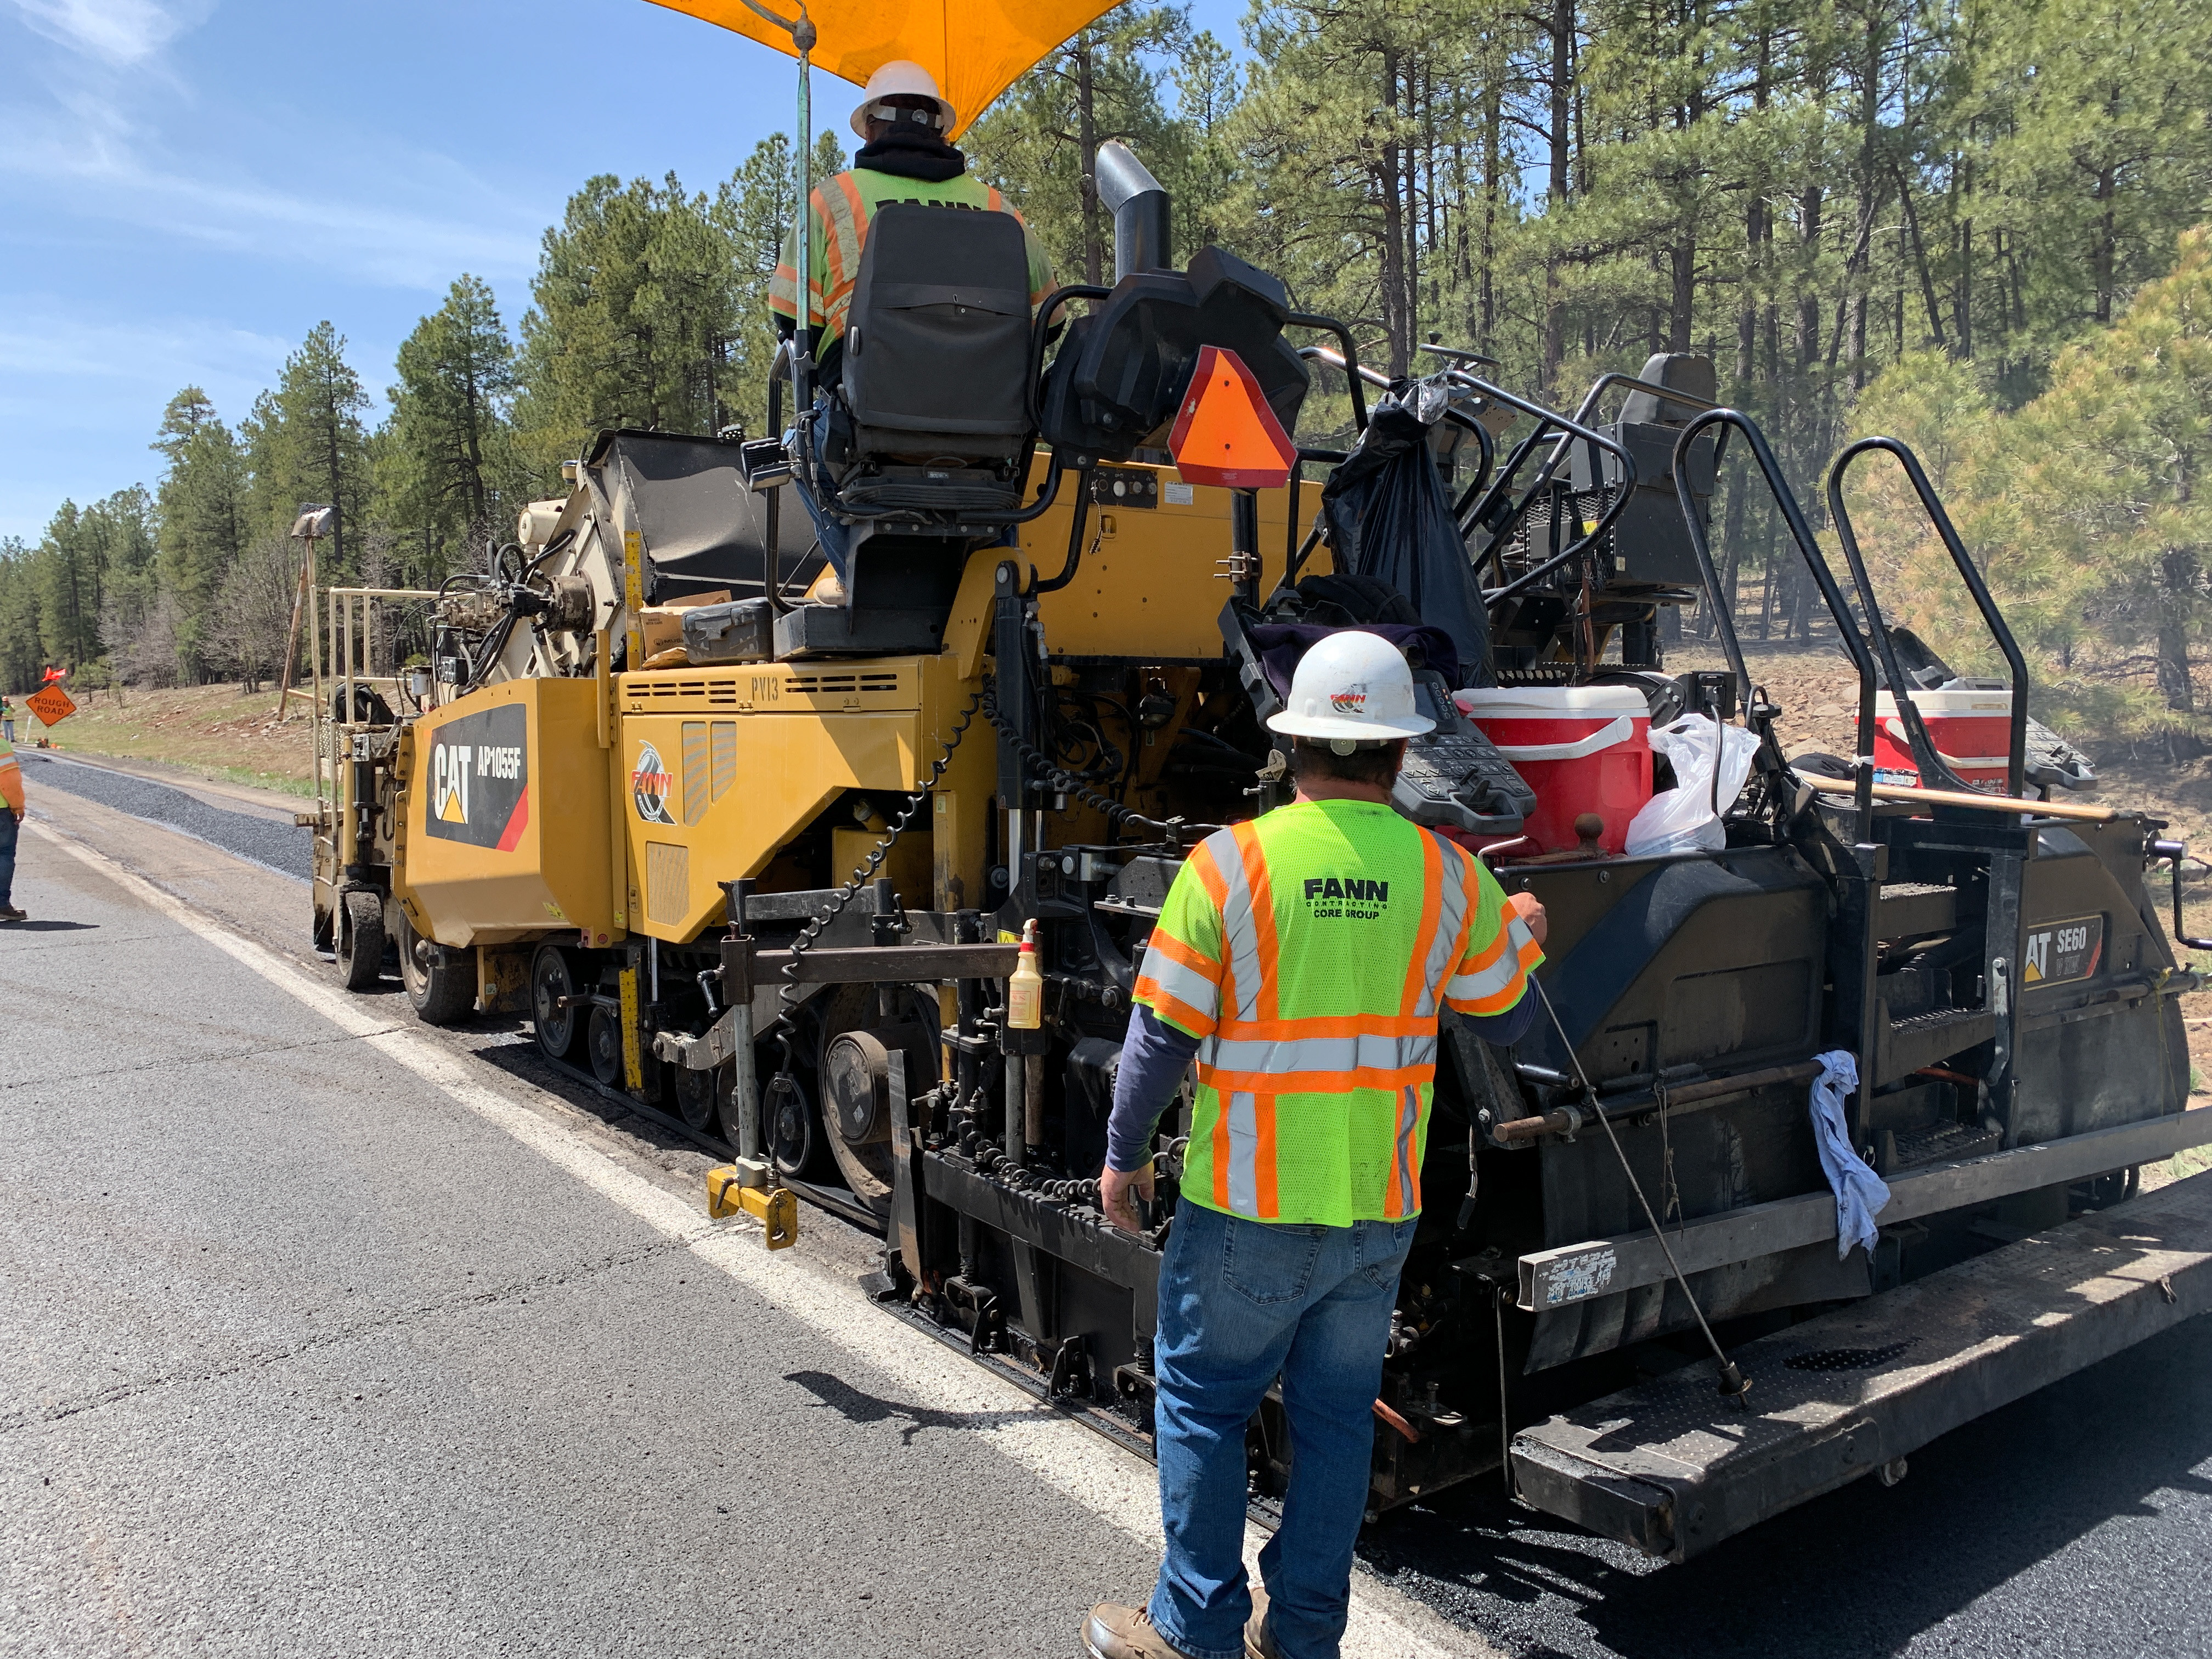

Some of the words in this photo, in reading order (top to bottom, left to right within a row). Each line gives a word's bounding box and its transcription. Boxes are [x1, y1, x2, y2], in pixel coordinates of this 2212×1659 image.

[34, 697, 69, 708] ROUGH
[1330, 694, 1367, 704] FANN
[37, 705, 64, 715] ROAD
[435, 743, 471, 824] CAT
[477, 745, 521, 780] AP1055F
[630, 770, 673, 797] FANN
[1304, 878, 1389, 902] FANN
[1306, 900, 1387, 910] CONTRACTING
[1314, 909, 1342, 918] CORE
[1345, 909, 1380, 919] GROUP
[2025, 932, 2051, 979] AT
[2057, 926, 2087, 953] SE60
